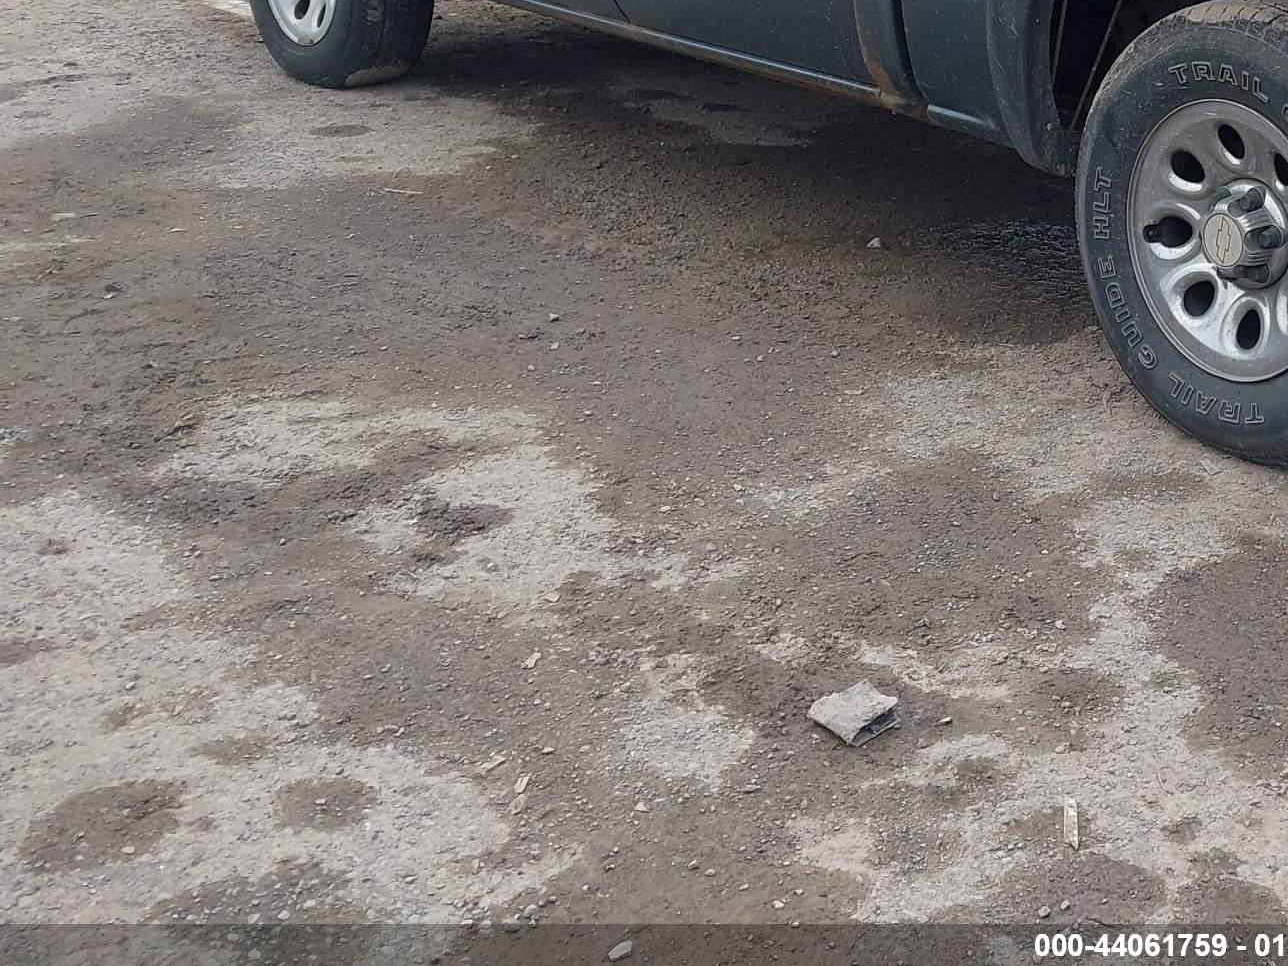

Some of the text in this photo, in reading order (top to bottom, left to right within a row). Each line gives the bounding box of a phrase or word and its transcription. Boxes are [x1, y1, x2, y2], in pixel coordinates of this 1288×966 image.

[1168, 61, 1269, 104] TRAIL
[1092, 166, 1266, 425] TRAIL GUIDE HLT
